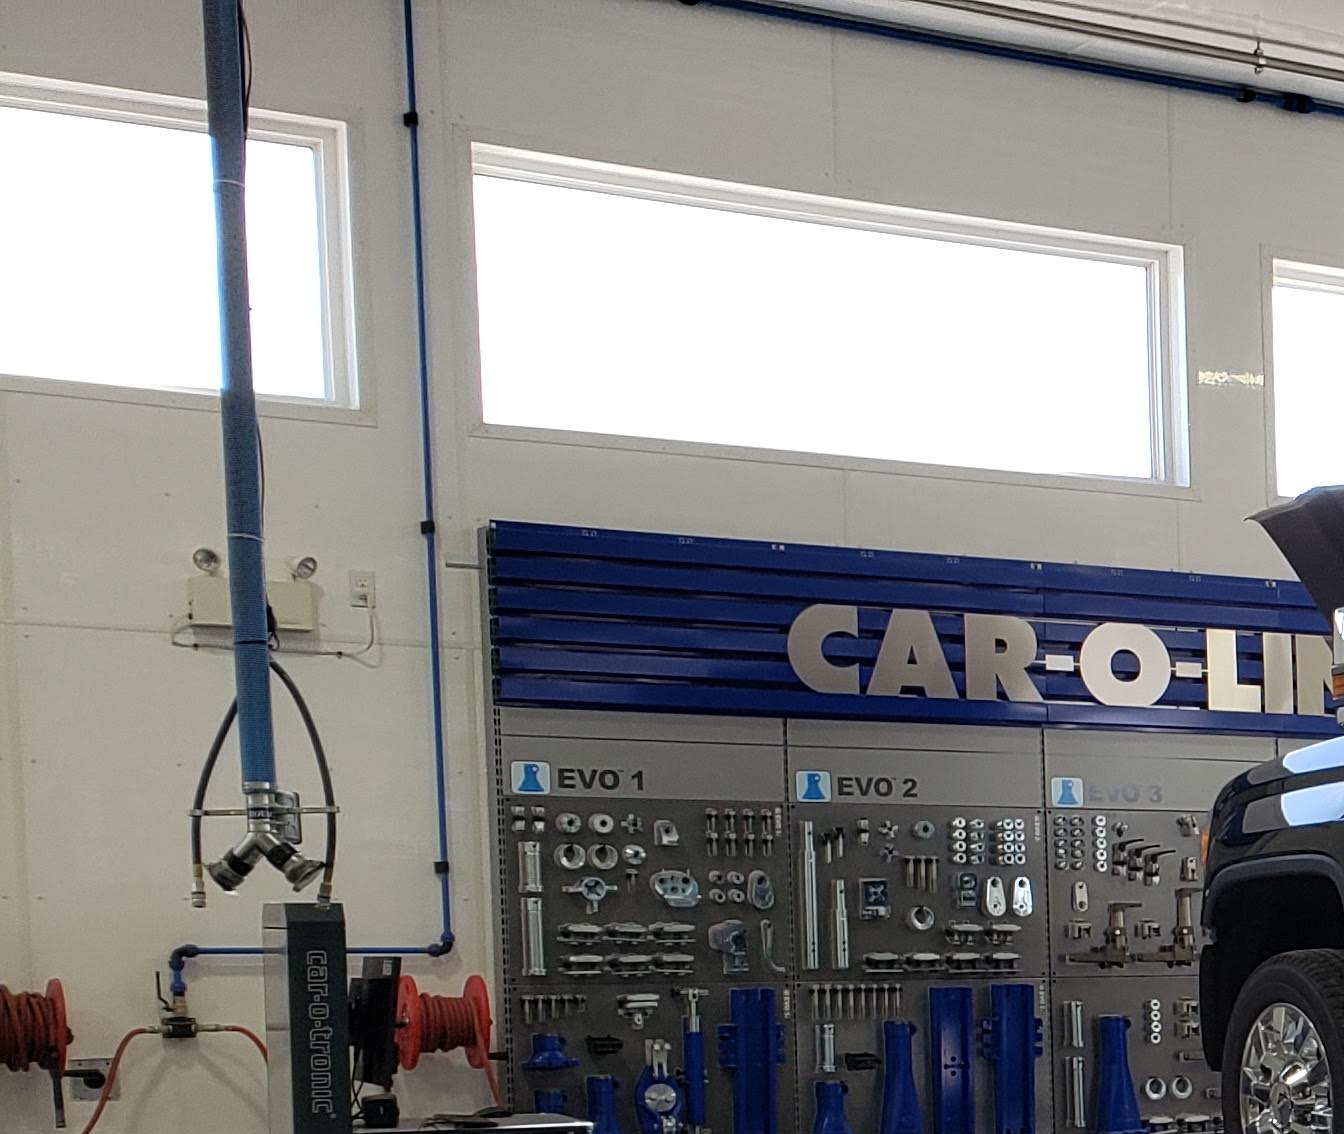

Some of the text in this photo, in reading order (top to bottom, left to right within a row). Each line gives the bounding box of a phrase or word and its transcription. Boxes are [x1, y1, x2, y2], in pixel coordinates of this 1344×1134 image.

[787, 603, 1334, 716] CAR-O-LIN
[631, 770, 644, 791] 1
[902, 777, 919, 798] 2
[1148, 785, 1163, 804] 3
